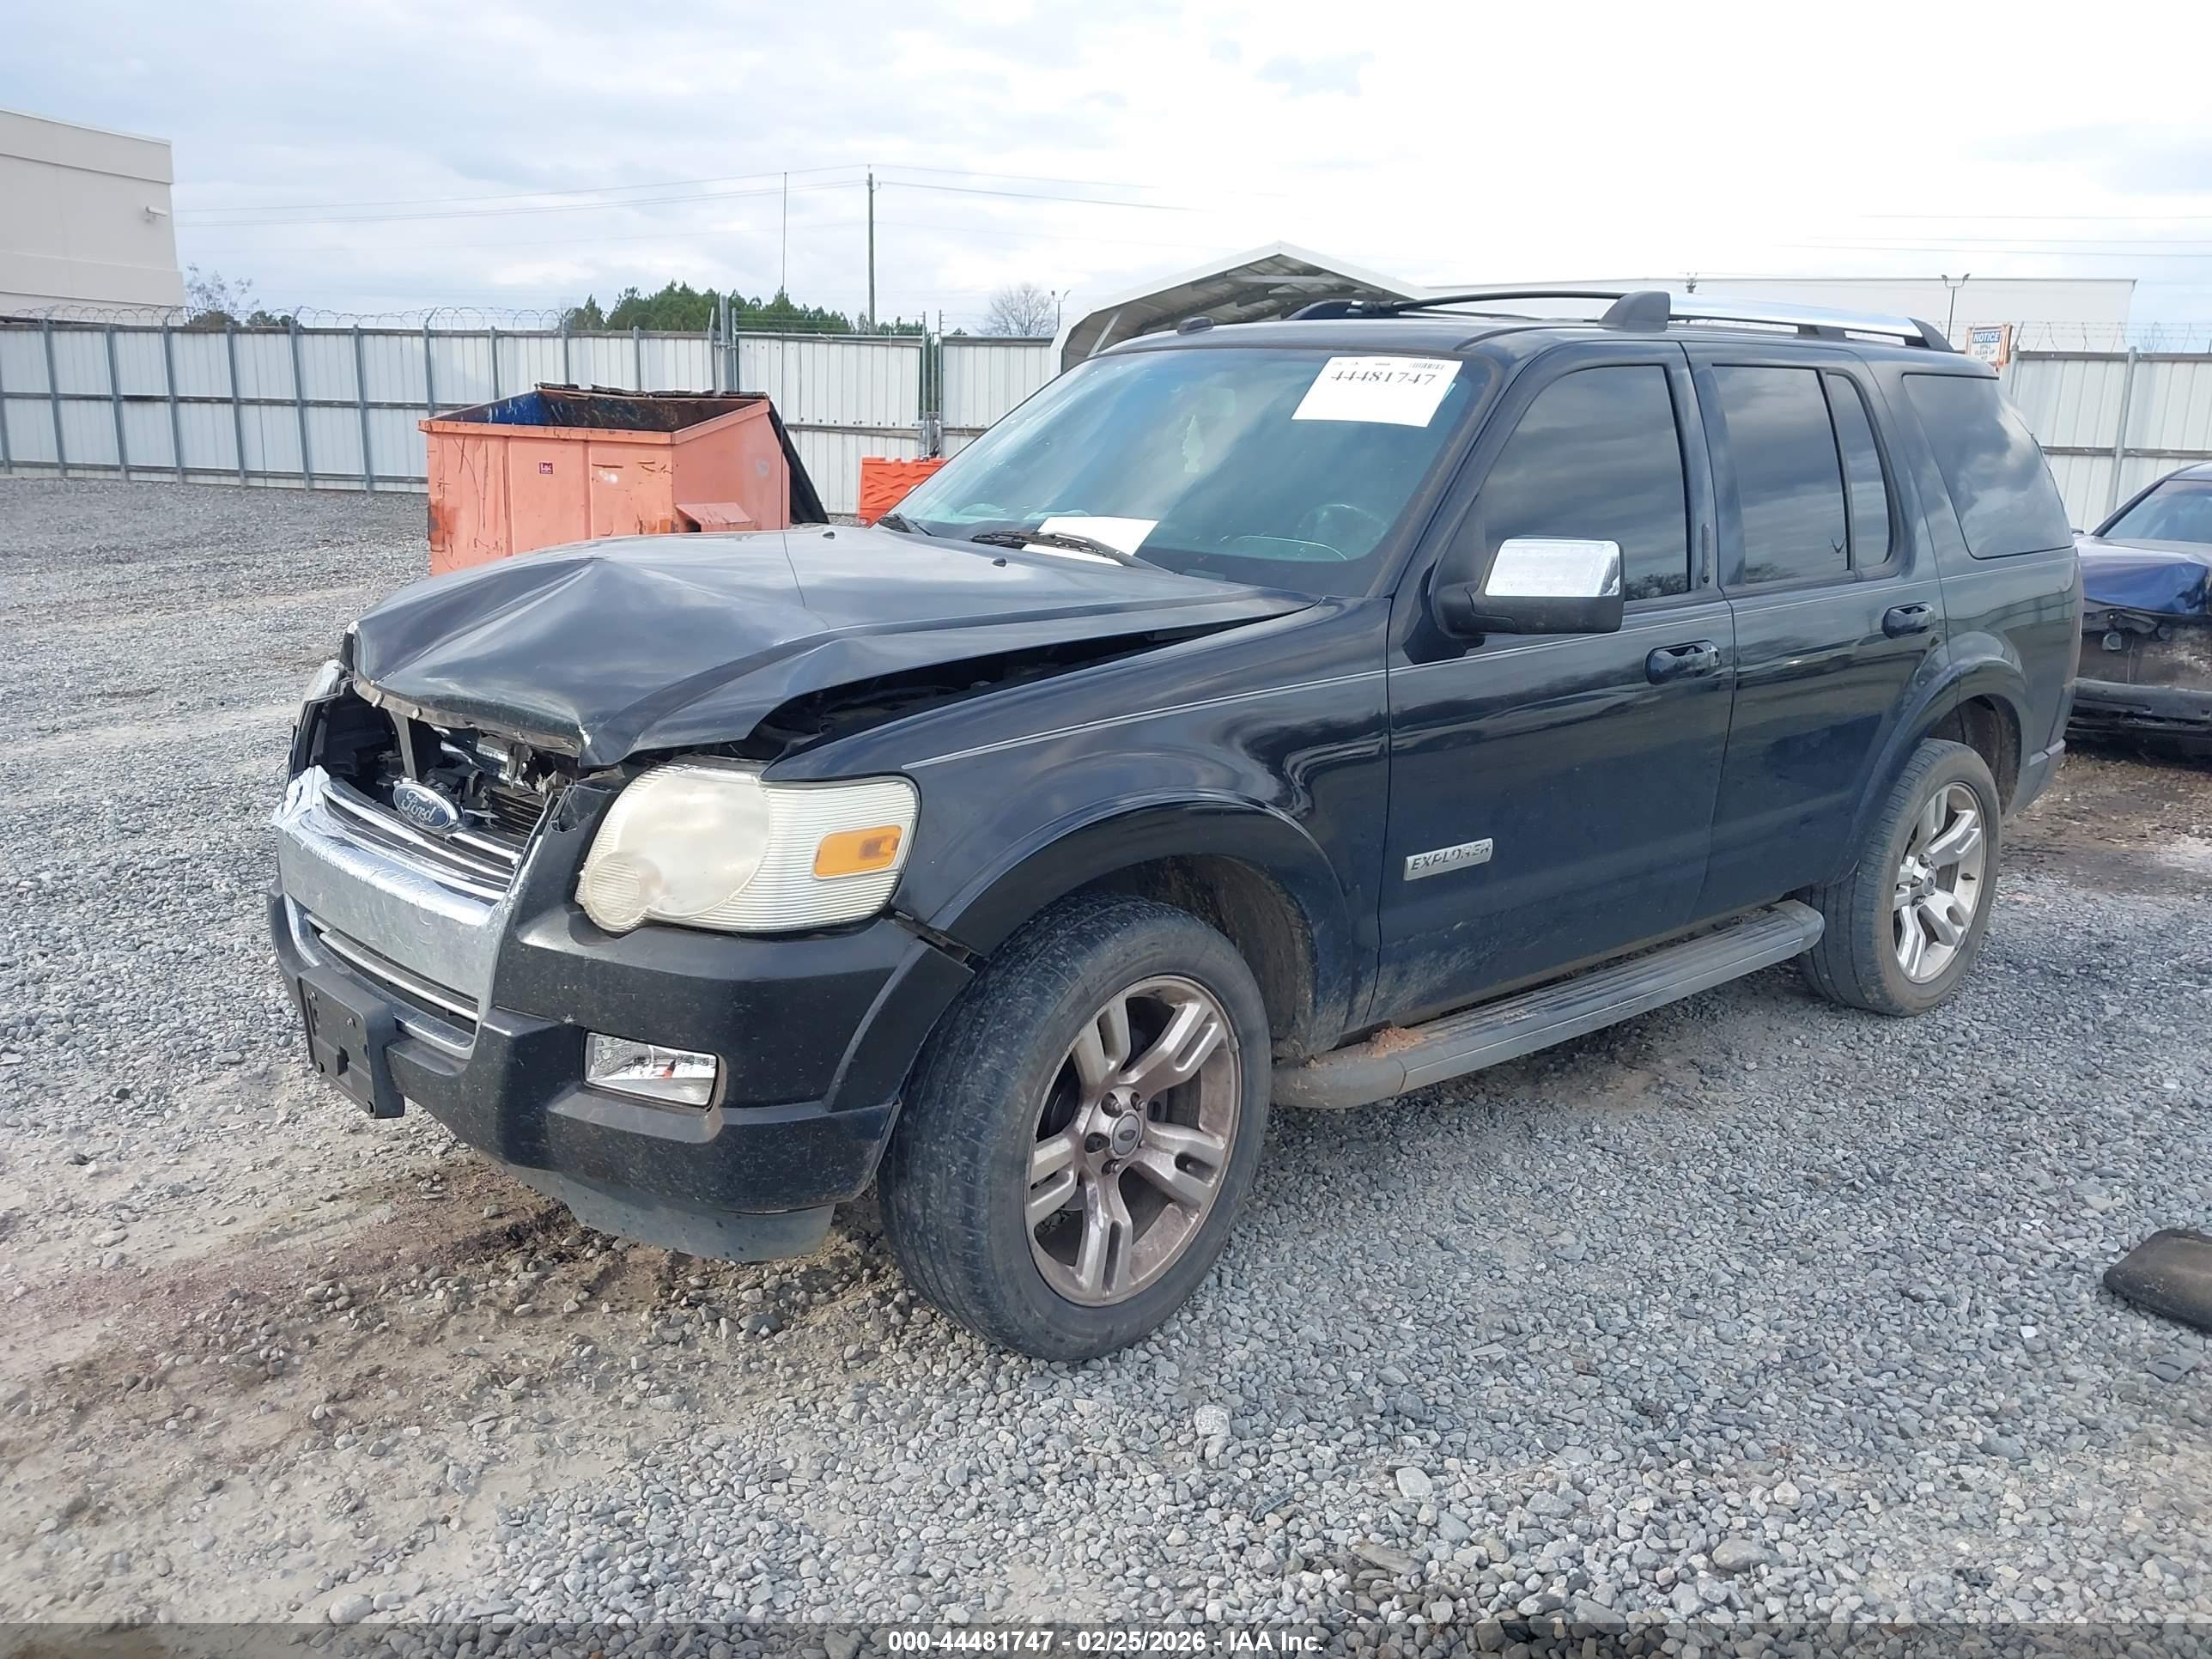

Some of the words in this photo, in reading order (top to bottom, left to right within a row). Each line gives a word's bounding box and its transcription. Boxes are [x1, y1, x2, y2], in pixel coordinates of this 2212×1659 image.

[1973, 331, 1999, 342] NOTICE
[1331, 370, 1437, 386] 44481747
[399, 790, 437, 823] Ford
